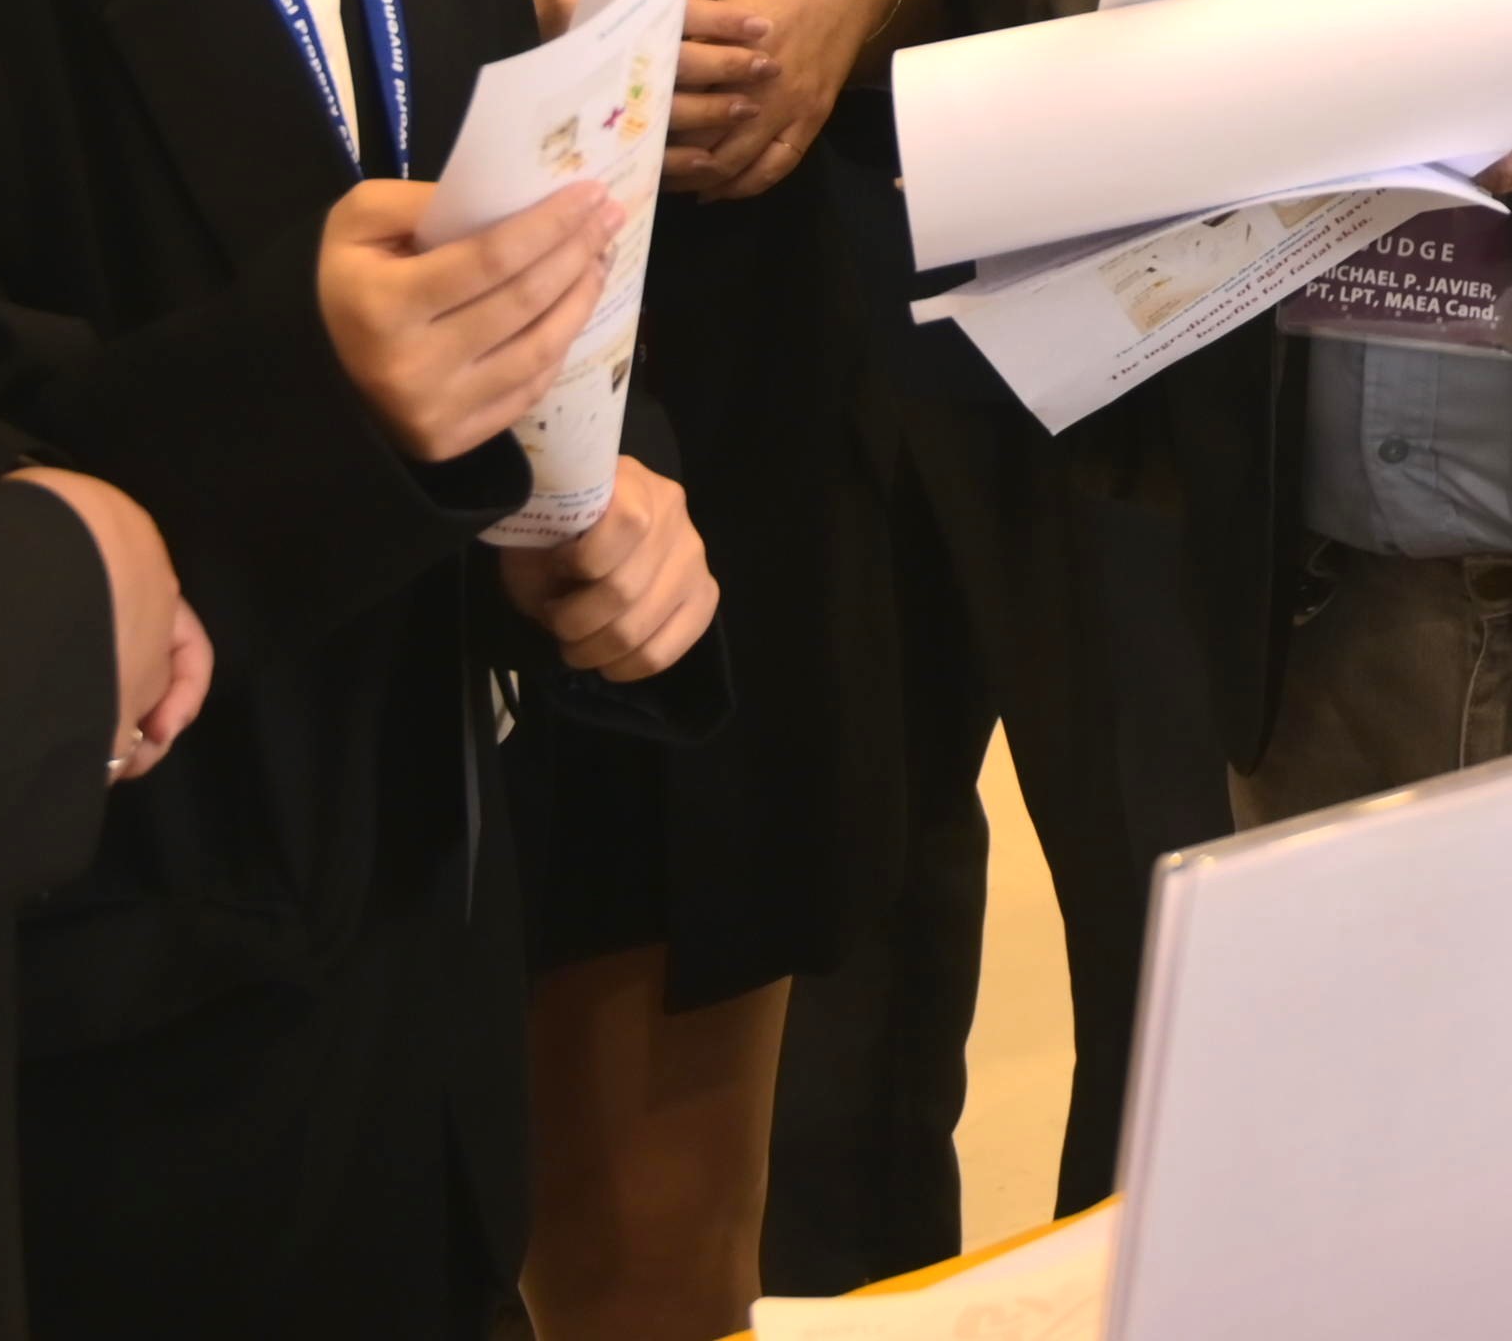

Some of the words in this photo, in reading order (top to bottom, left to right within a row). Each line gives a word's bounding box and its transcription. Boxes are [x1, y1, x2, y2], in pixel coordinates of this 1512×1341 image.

[293, 15, 341, 121] Property
[1196, 296, 1260, 340] benefits
[1262, 277, 1287, 296] for
[1289, 242, 1334, 276] facial
[1335, 216, 1374, 244] skin.
[1360, 236, 1456, 263] UDGE
[1144, 297, 1234, 360] ingredients
[1236, 281, 1253, 298] of
[1255, 224, 1333, 282] agarwood
[1305, 281, 1334, 303] PT,
[1339, 285, 1380, 308] LPT,
[1384, 291, 1441, 315] MAEA
[1445, 300, 1501, 322] Cand.
[1403, 274, 1422, 291] P.
[1425, 276, 1498, 302] JAVIER,
